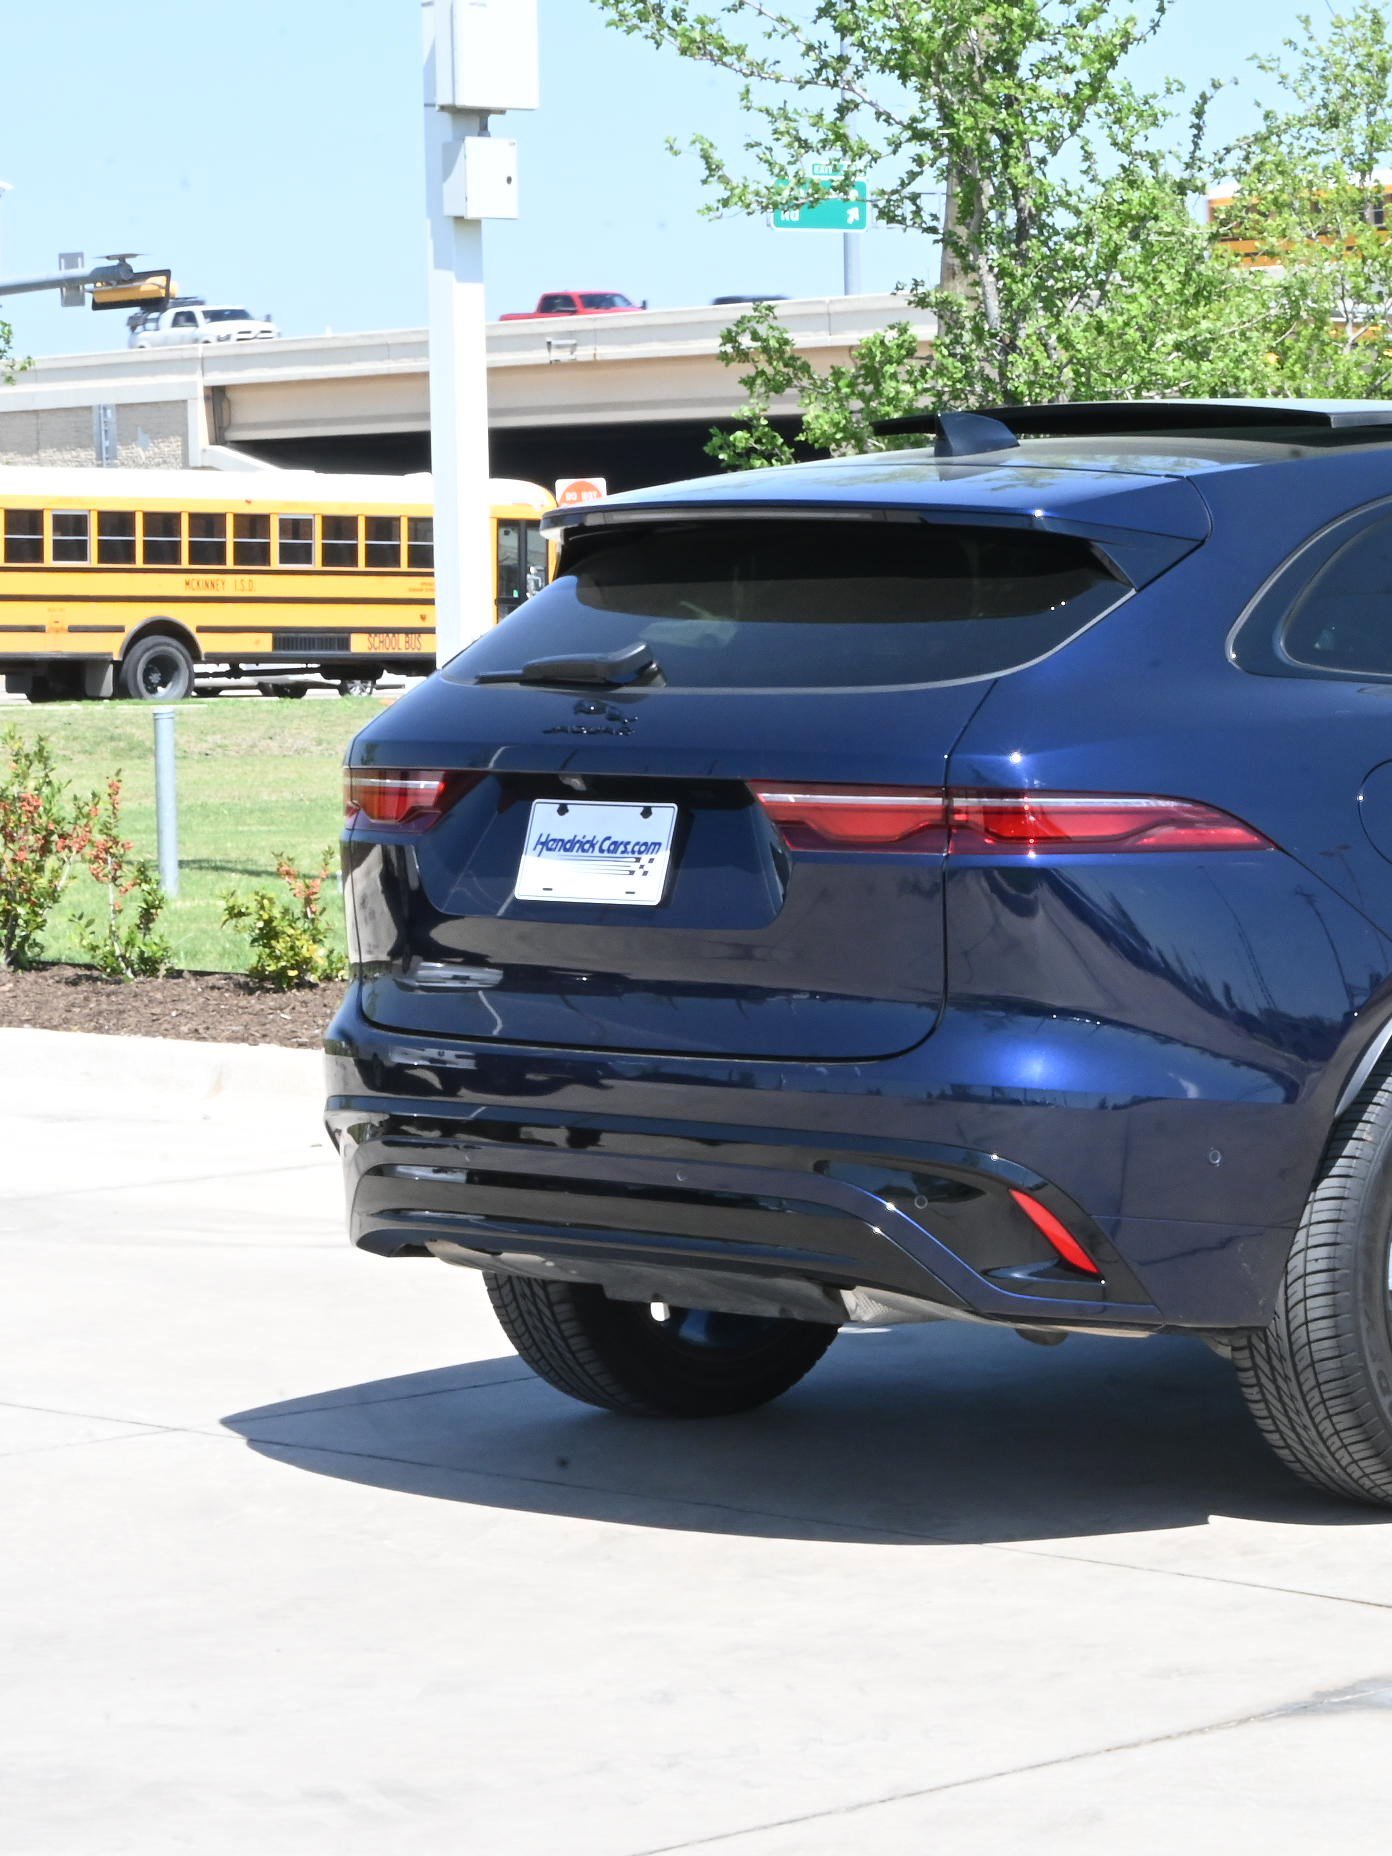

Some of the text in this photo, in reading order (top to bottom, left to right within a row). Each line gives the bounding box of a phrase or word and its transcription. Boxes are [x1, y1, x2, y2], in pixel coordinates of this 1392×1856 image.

[184, 578, 226, 593] MCKINNEY
[367, 633, 422, 651] SCHOOL BUS
